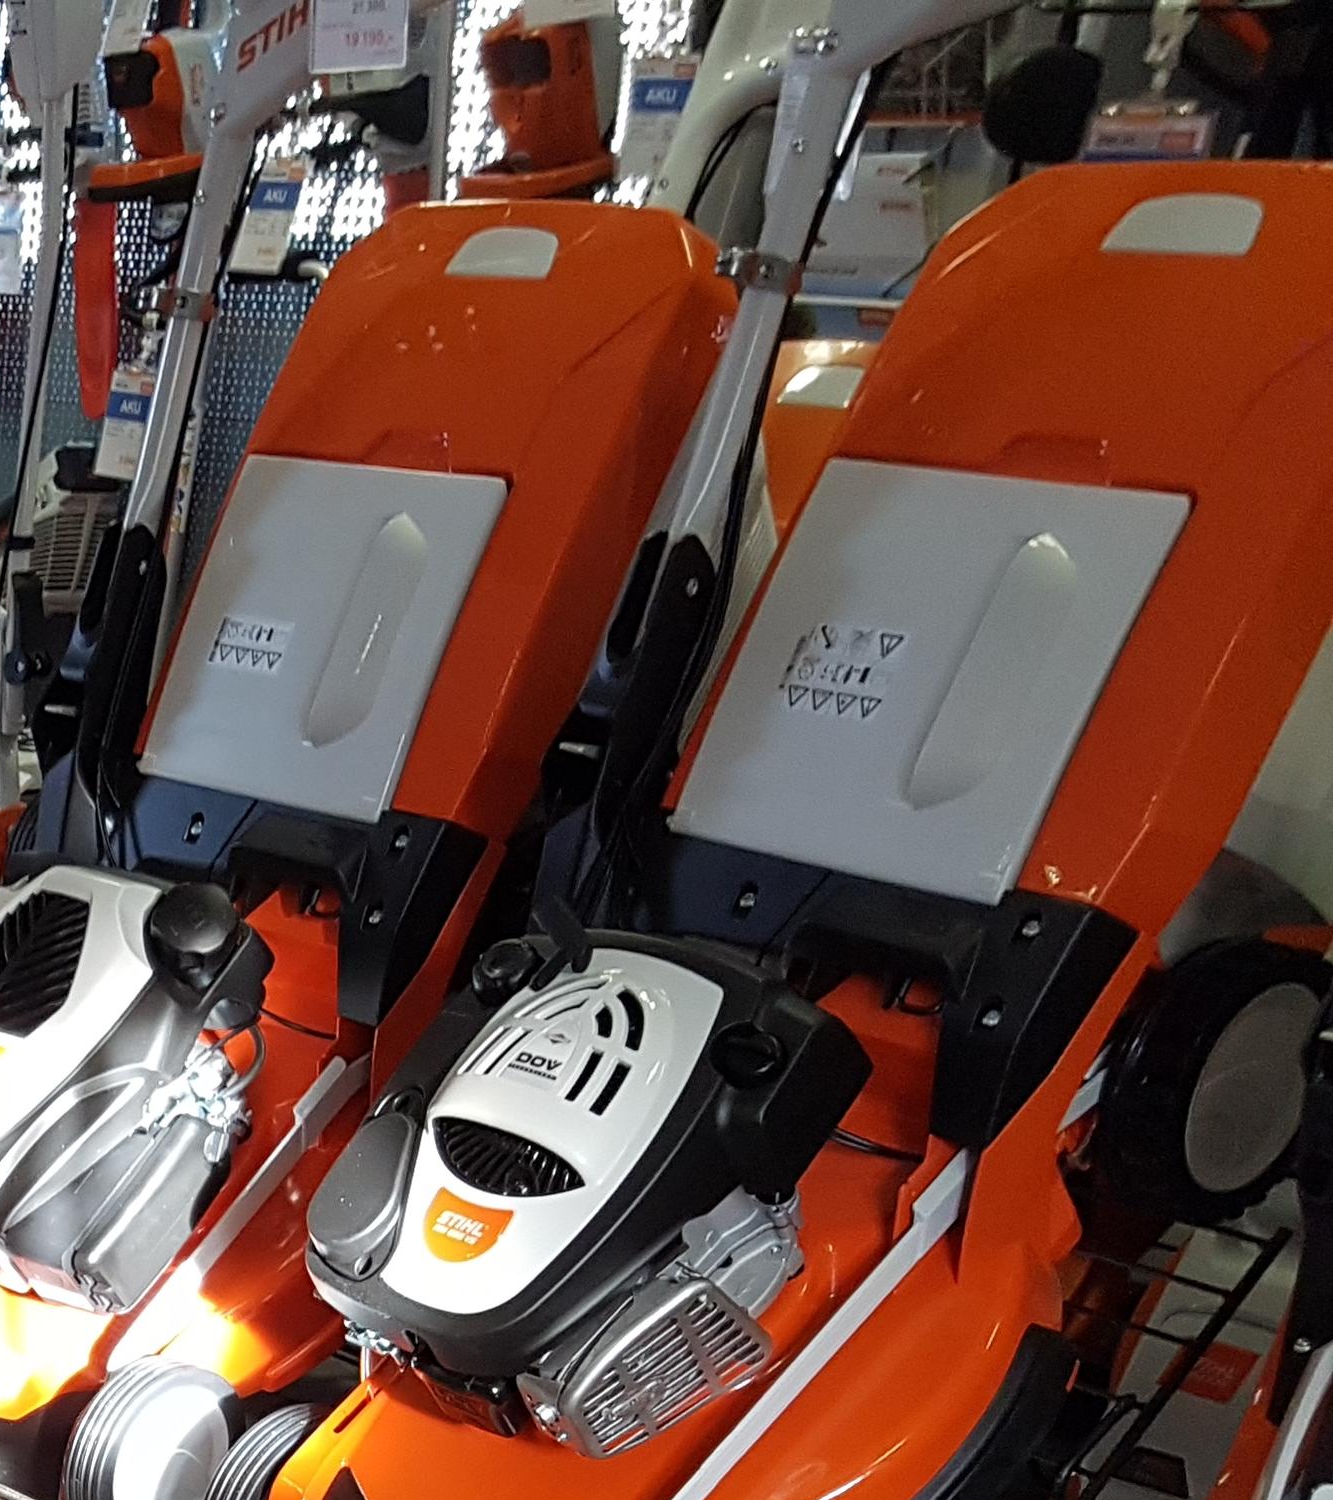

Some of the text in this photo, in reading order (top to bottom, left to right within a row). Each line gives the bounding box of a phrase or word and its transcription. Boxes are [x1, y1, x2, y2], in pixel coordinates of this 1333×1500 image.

[263, 189, 288, 203] AKU
[119, 399, 142, 415] AKU
[436, 1209, 485, 1238] STIHL
